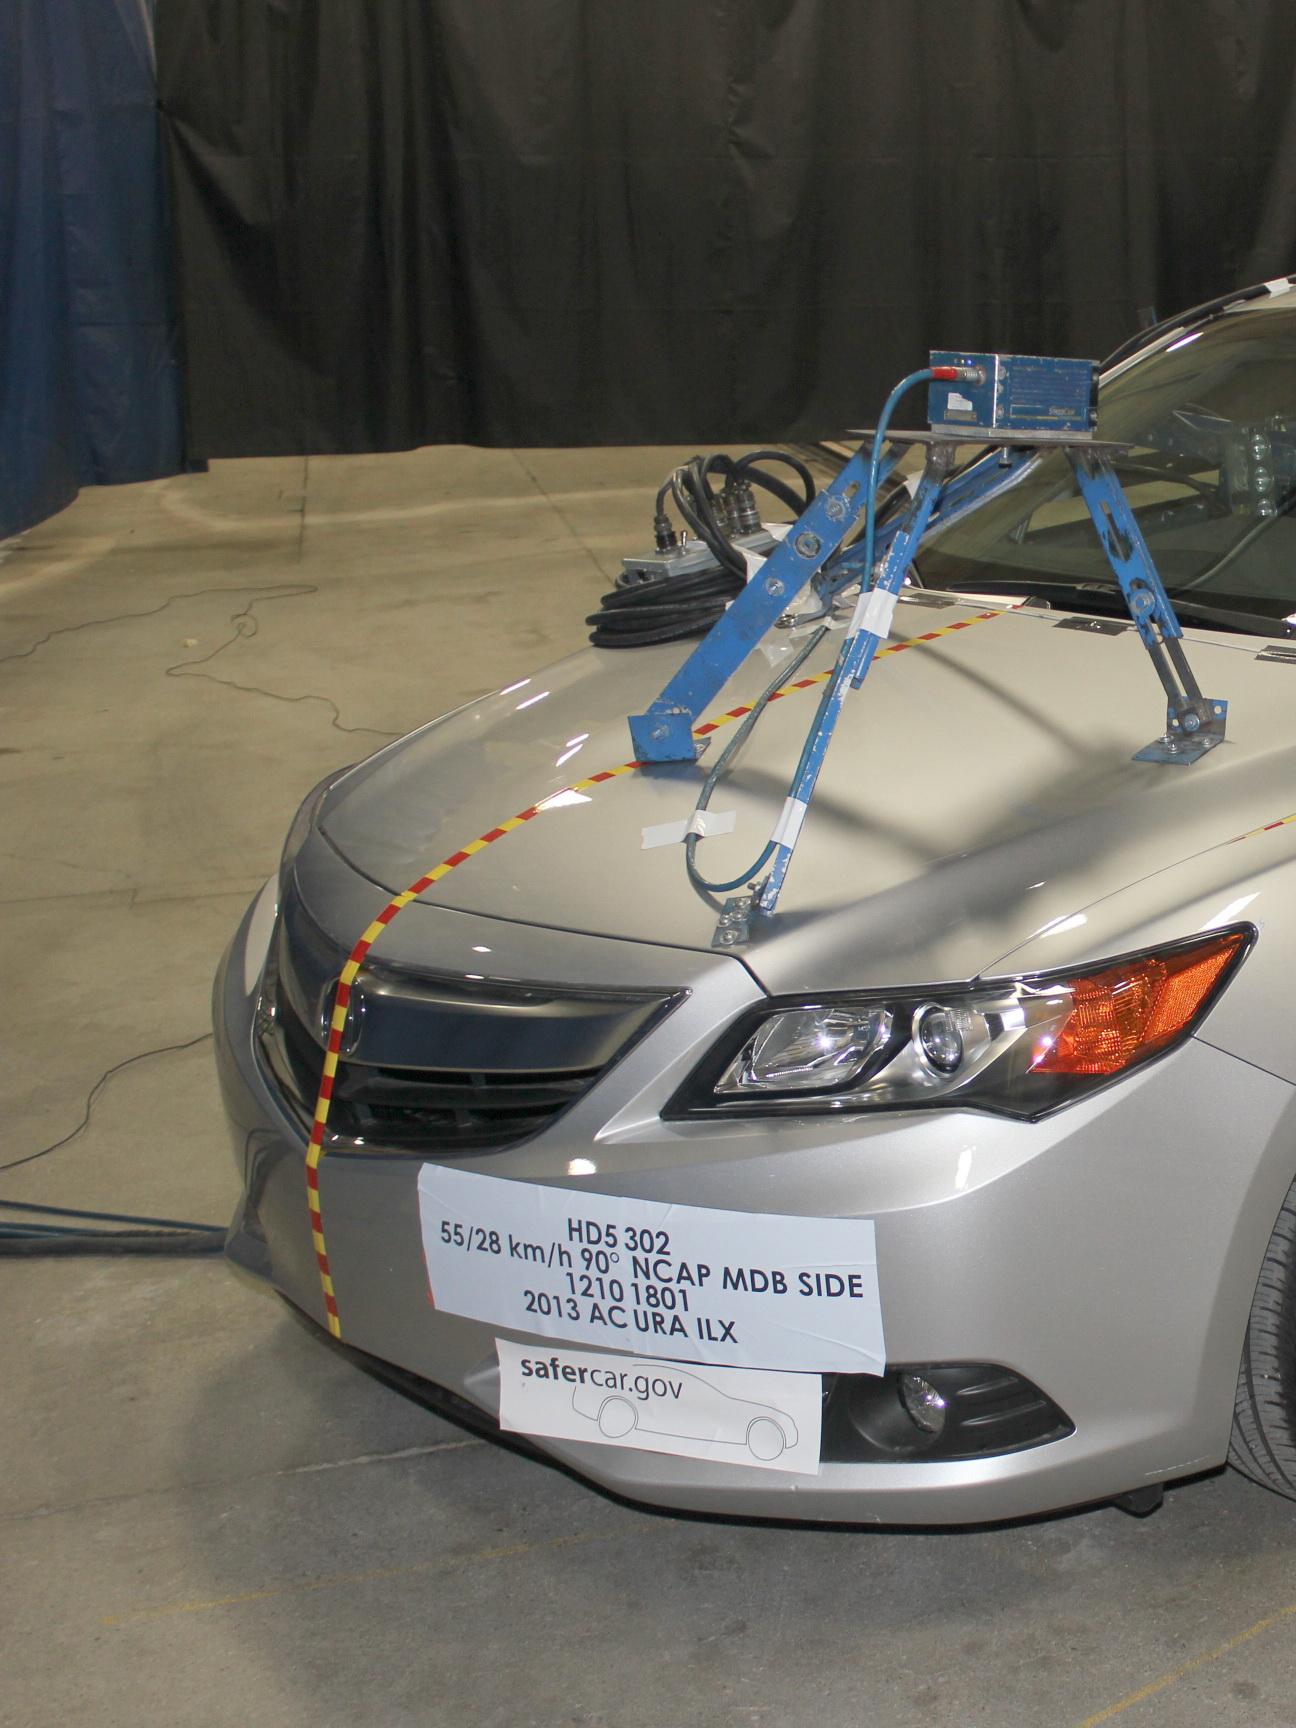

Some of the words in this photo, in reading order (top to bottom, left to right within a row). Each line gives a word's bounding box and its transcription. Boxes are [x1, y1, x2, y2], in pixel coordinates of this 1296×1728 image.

[440, 1221, 502, 1255] 55/28
[508, 1234, 573, 1269] km/h
[632, 1255, 711, 1287] NCAP
[723, 1267, 788, 1295] MDB
[799, 1273, 864, 1298] SIDE
[524, 1290, 581, 1321] 2013
[697, 1318, 739, 1344] ILX
[521, 1357, 683, 1401] safercar.gov
